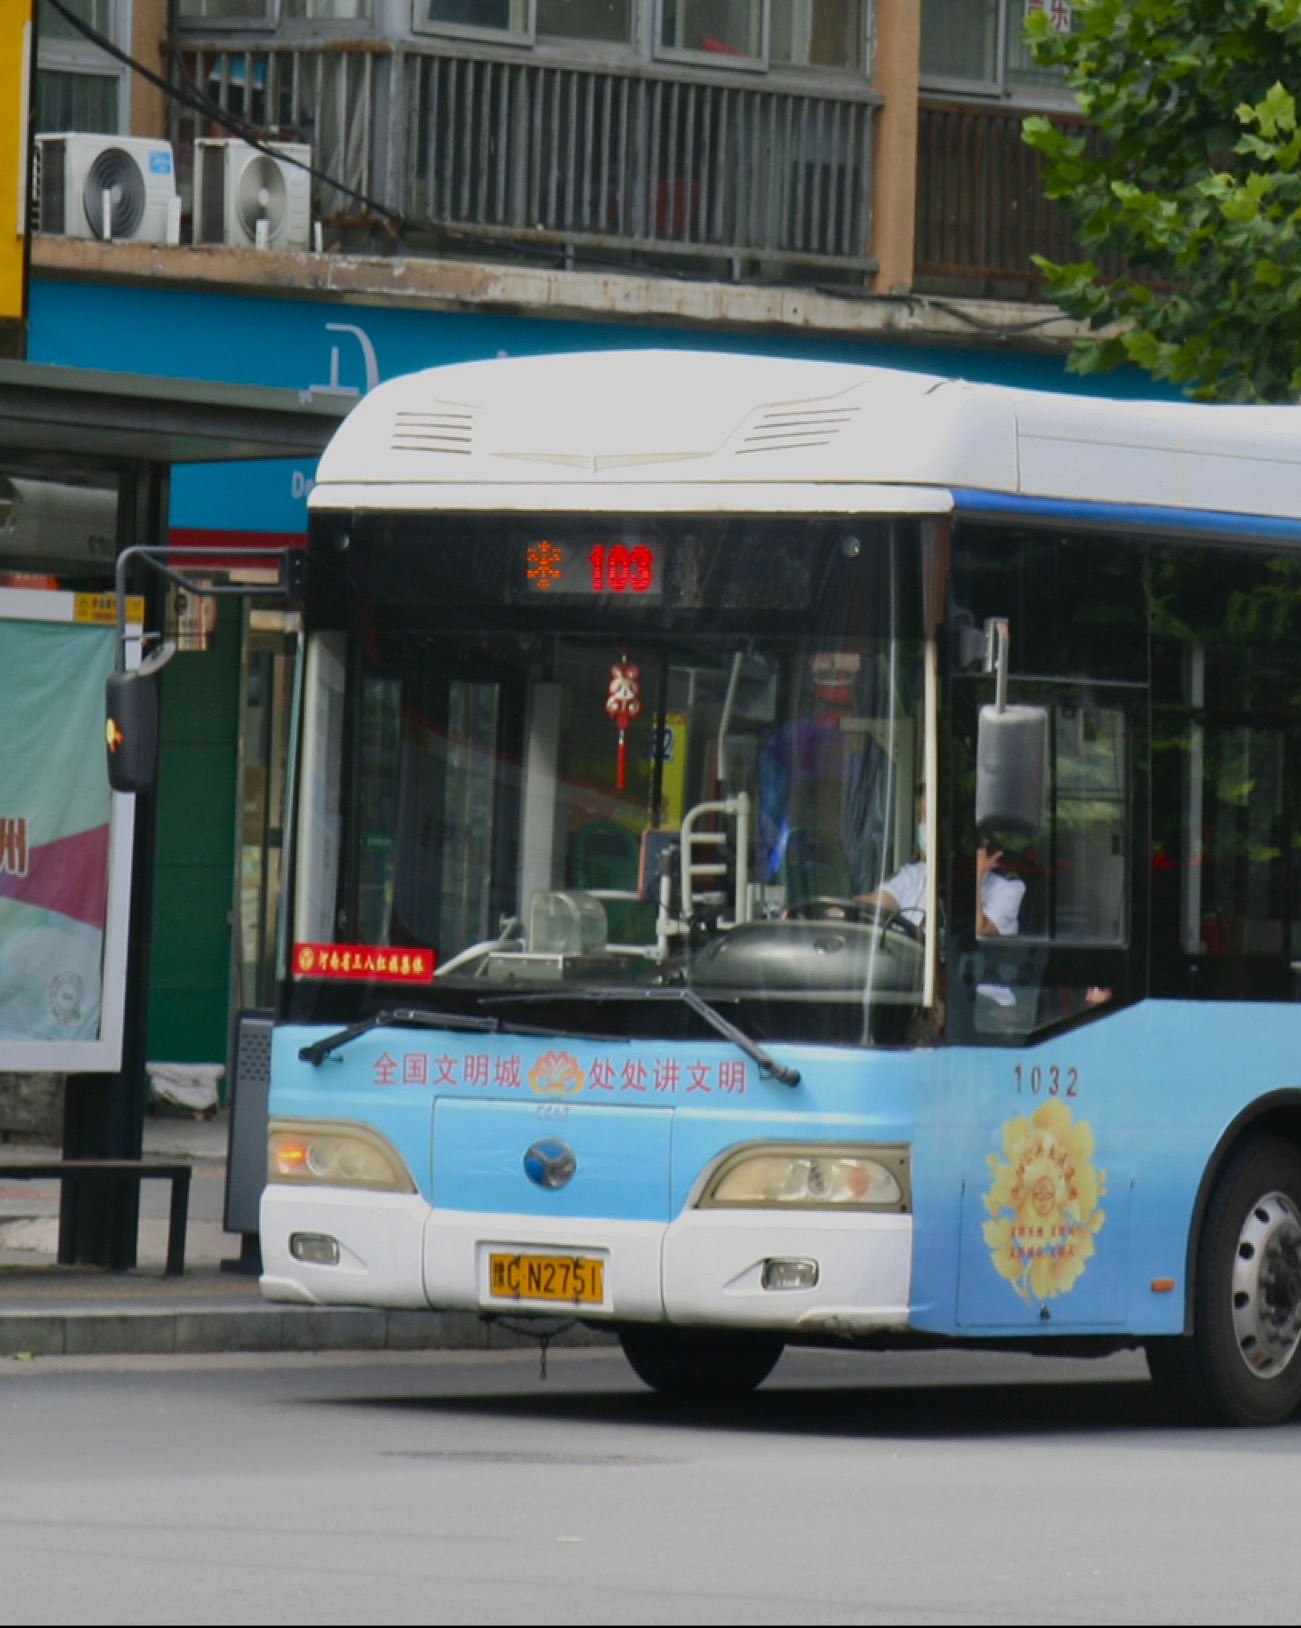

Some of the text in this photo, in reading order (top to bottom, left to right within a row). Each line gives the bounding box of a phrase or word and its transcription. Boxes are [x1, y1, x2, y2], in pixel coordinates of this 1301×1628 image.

[373, 1050, 747, 1095] 全国文明城 处处讲文明
[1015, 1065, 1078, 1096] 1032
